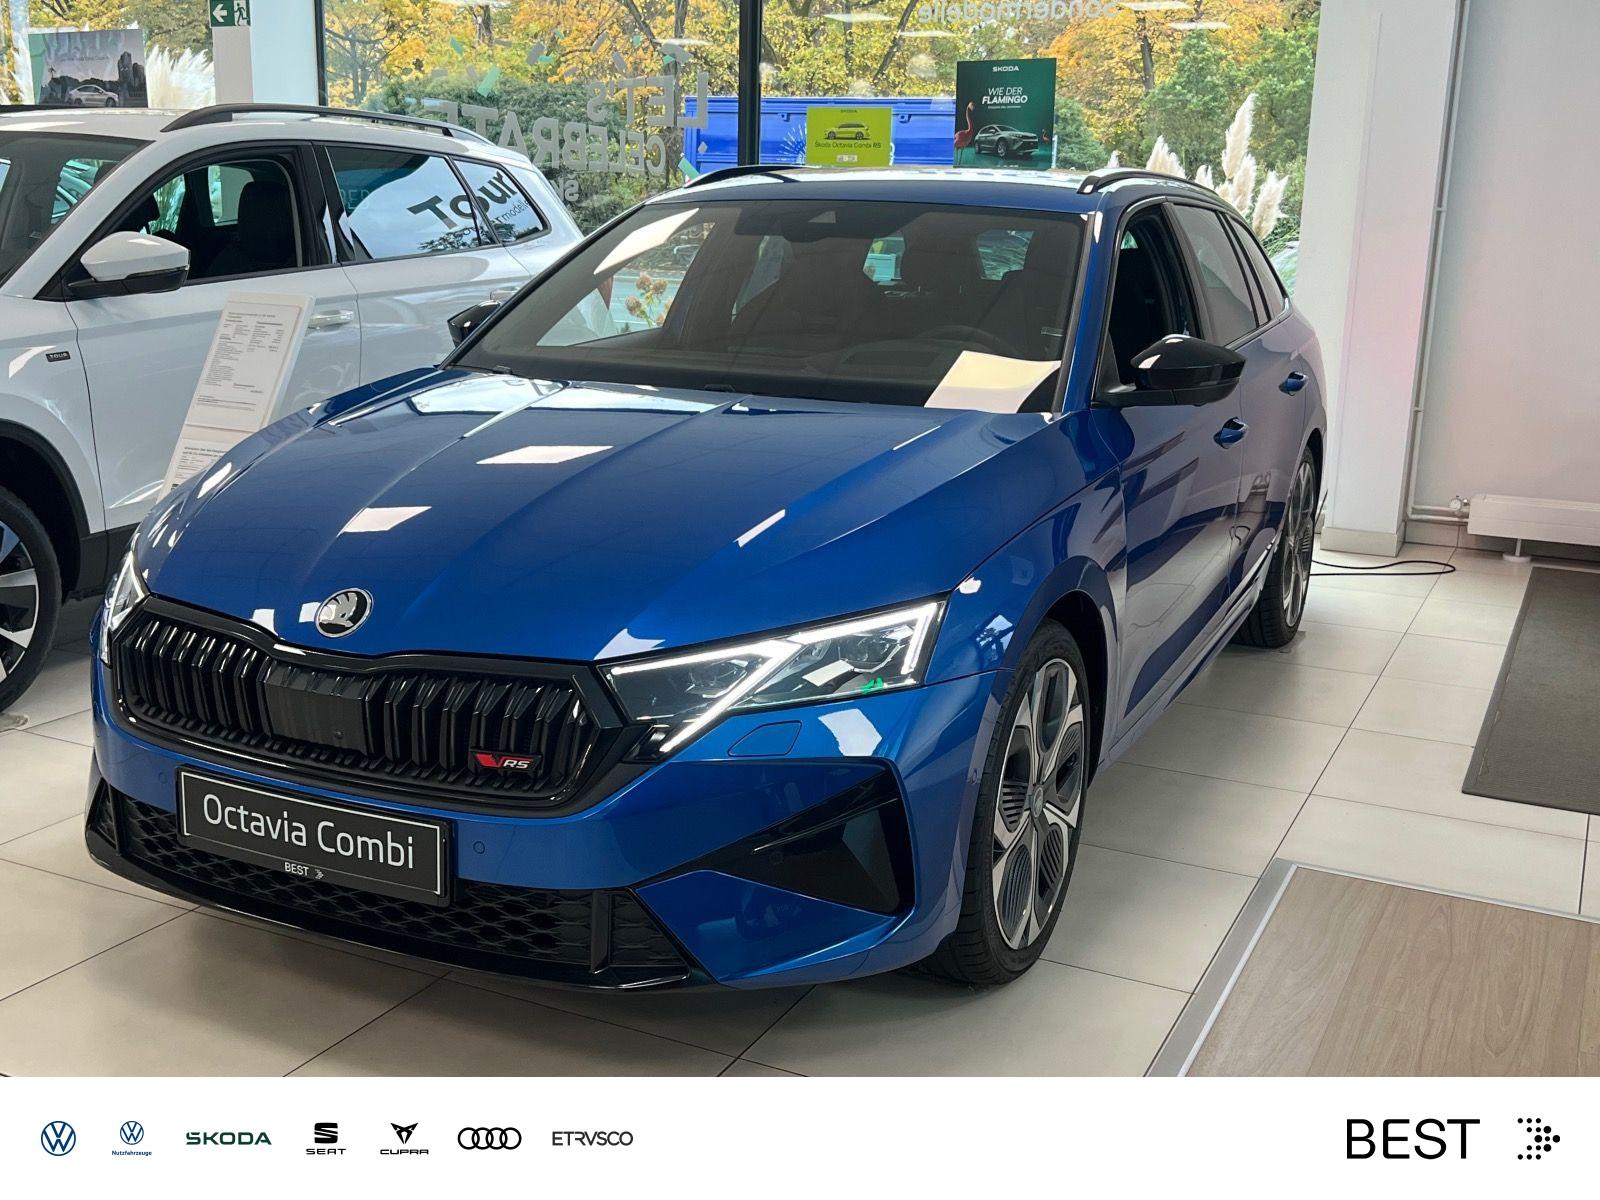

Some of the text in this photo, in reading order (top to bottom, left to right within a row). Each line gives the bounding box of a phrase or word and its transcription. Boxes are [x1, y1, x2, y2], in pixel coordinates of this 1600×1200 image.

[988, 86, 1023, 96] WIE DER
[981, 95, 1029, 105] FLAMINGO
[407, 170, 518, 230] Tour
[203, 793, 414, 869] Octavia Combi
[284, 861, 309, 877] BEST
